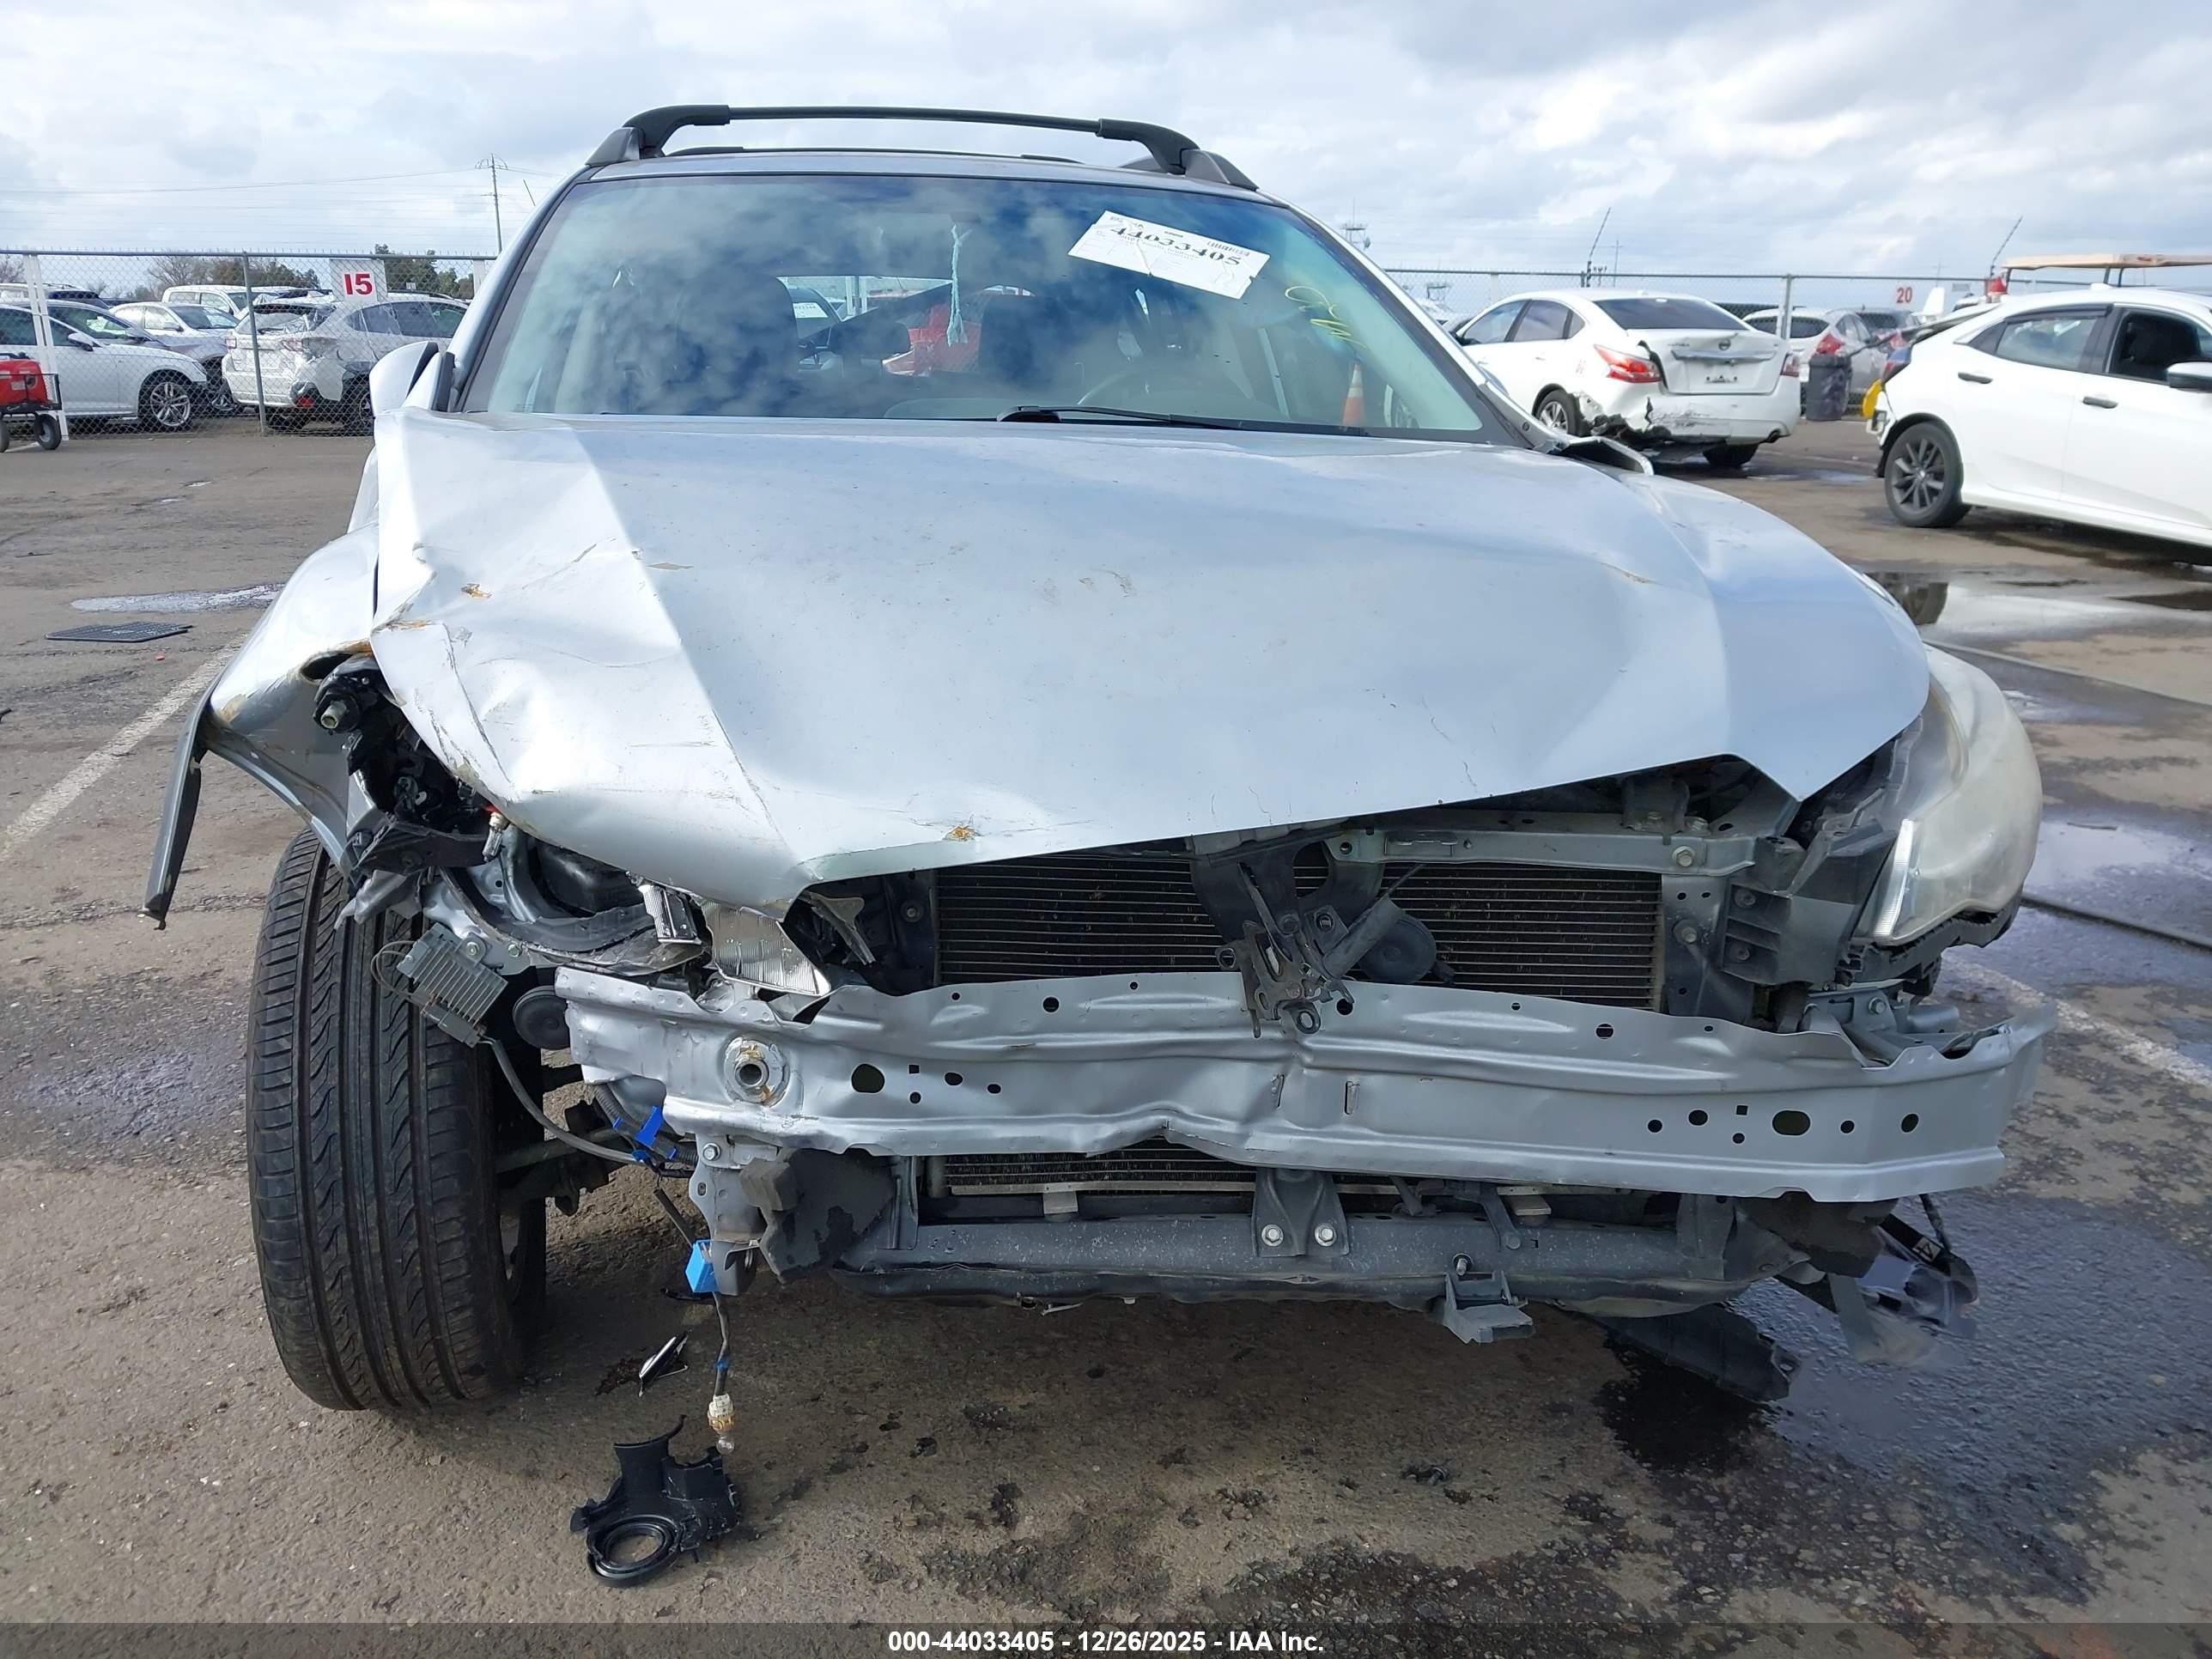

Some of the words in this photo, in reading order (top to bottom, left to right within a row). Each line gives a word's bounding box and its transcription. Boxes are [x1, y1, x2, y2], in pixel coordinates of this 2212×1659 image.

[1110, 227, 1242, 265] 44033405
[343, 272, 373, 295] 15
[1896, 286, 1913, 304] 20
